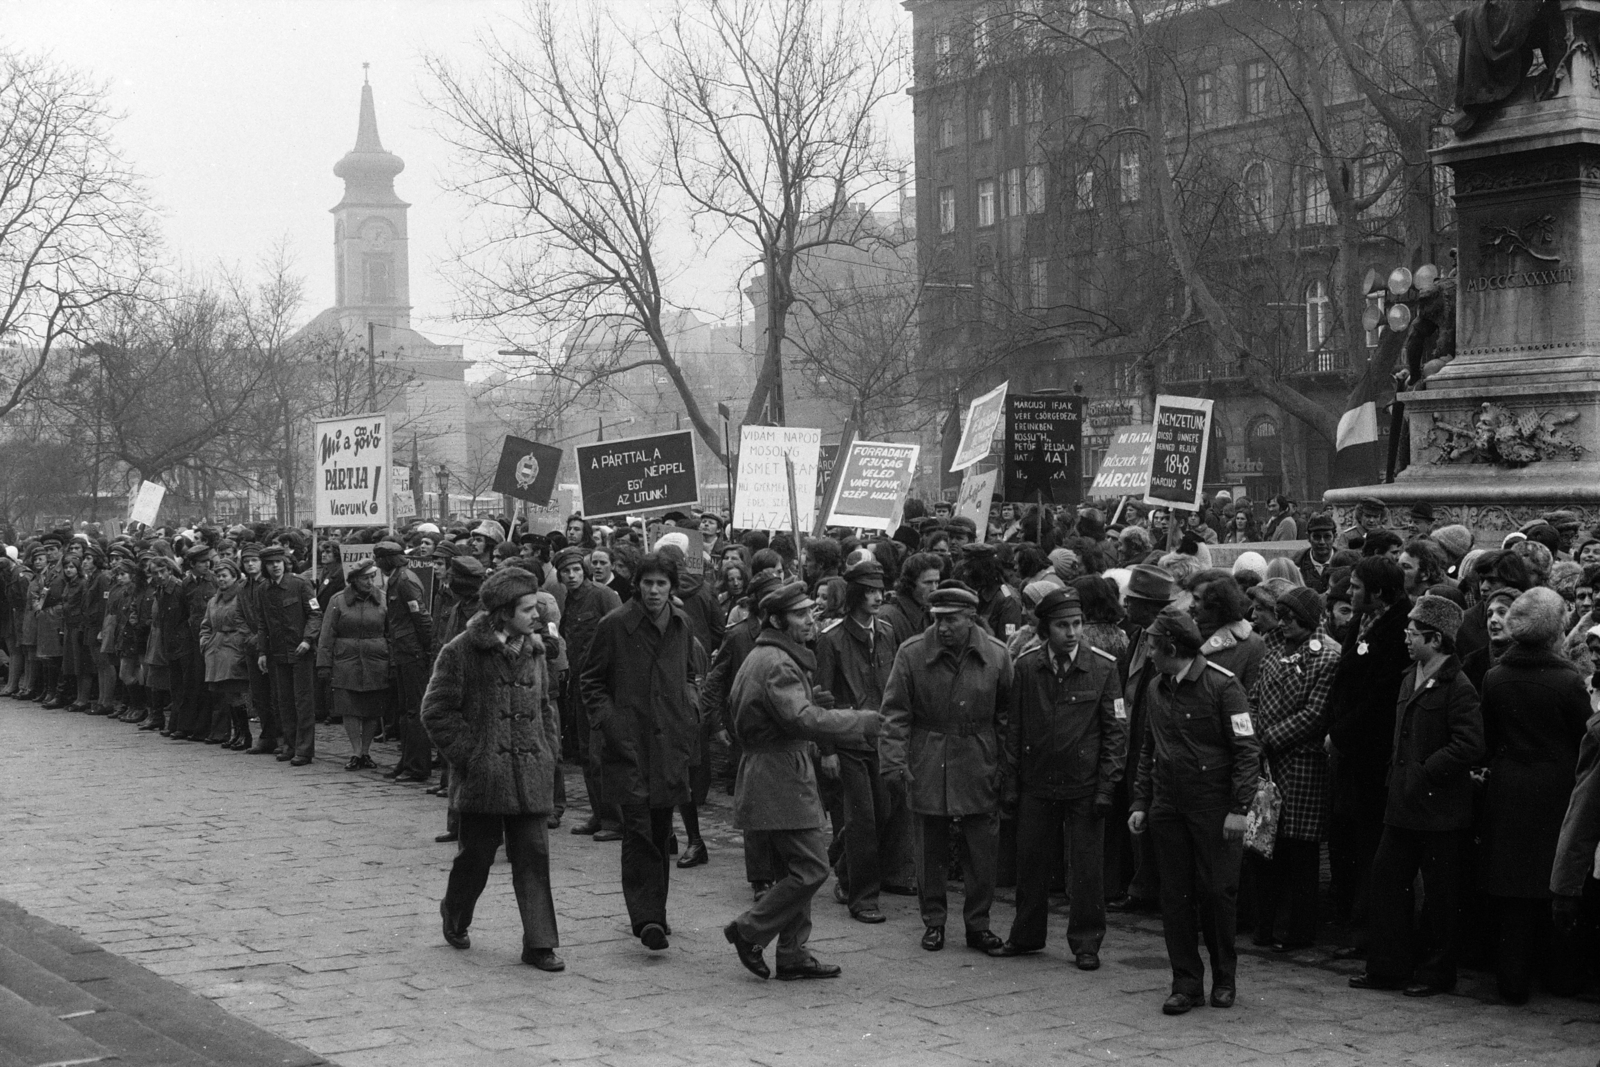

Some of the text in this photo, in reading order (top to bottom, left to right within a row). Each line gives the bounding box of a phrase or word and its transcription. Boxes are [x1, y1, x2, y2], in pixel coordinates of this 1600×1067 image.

[1052, 401, 1073, 410] IFJAK
[1014, 410, 1031, 420] VÉRE
[343, 435, 351, 450] a
[783, 431, 819, 444] NAPOD
[750, 445, 800, 457] MOSOLYG
[591, 455, 599, 469] A
[653, 448, 662, 460] A
[1164, 454, 1191, 476] 1848.
[325, 461, 369, 490] PÁRTJA
[644, 461, 686, 478] NÉPPEL
[862, 469, 895, 478] VELED
[627, 478, 644, 491] EGY
[1093, 469, 1148, 488] MÁRCIUS
[1182, 479, 1194, 492] 15.
[617, 484, 668, 506] AZ UTUNK!
